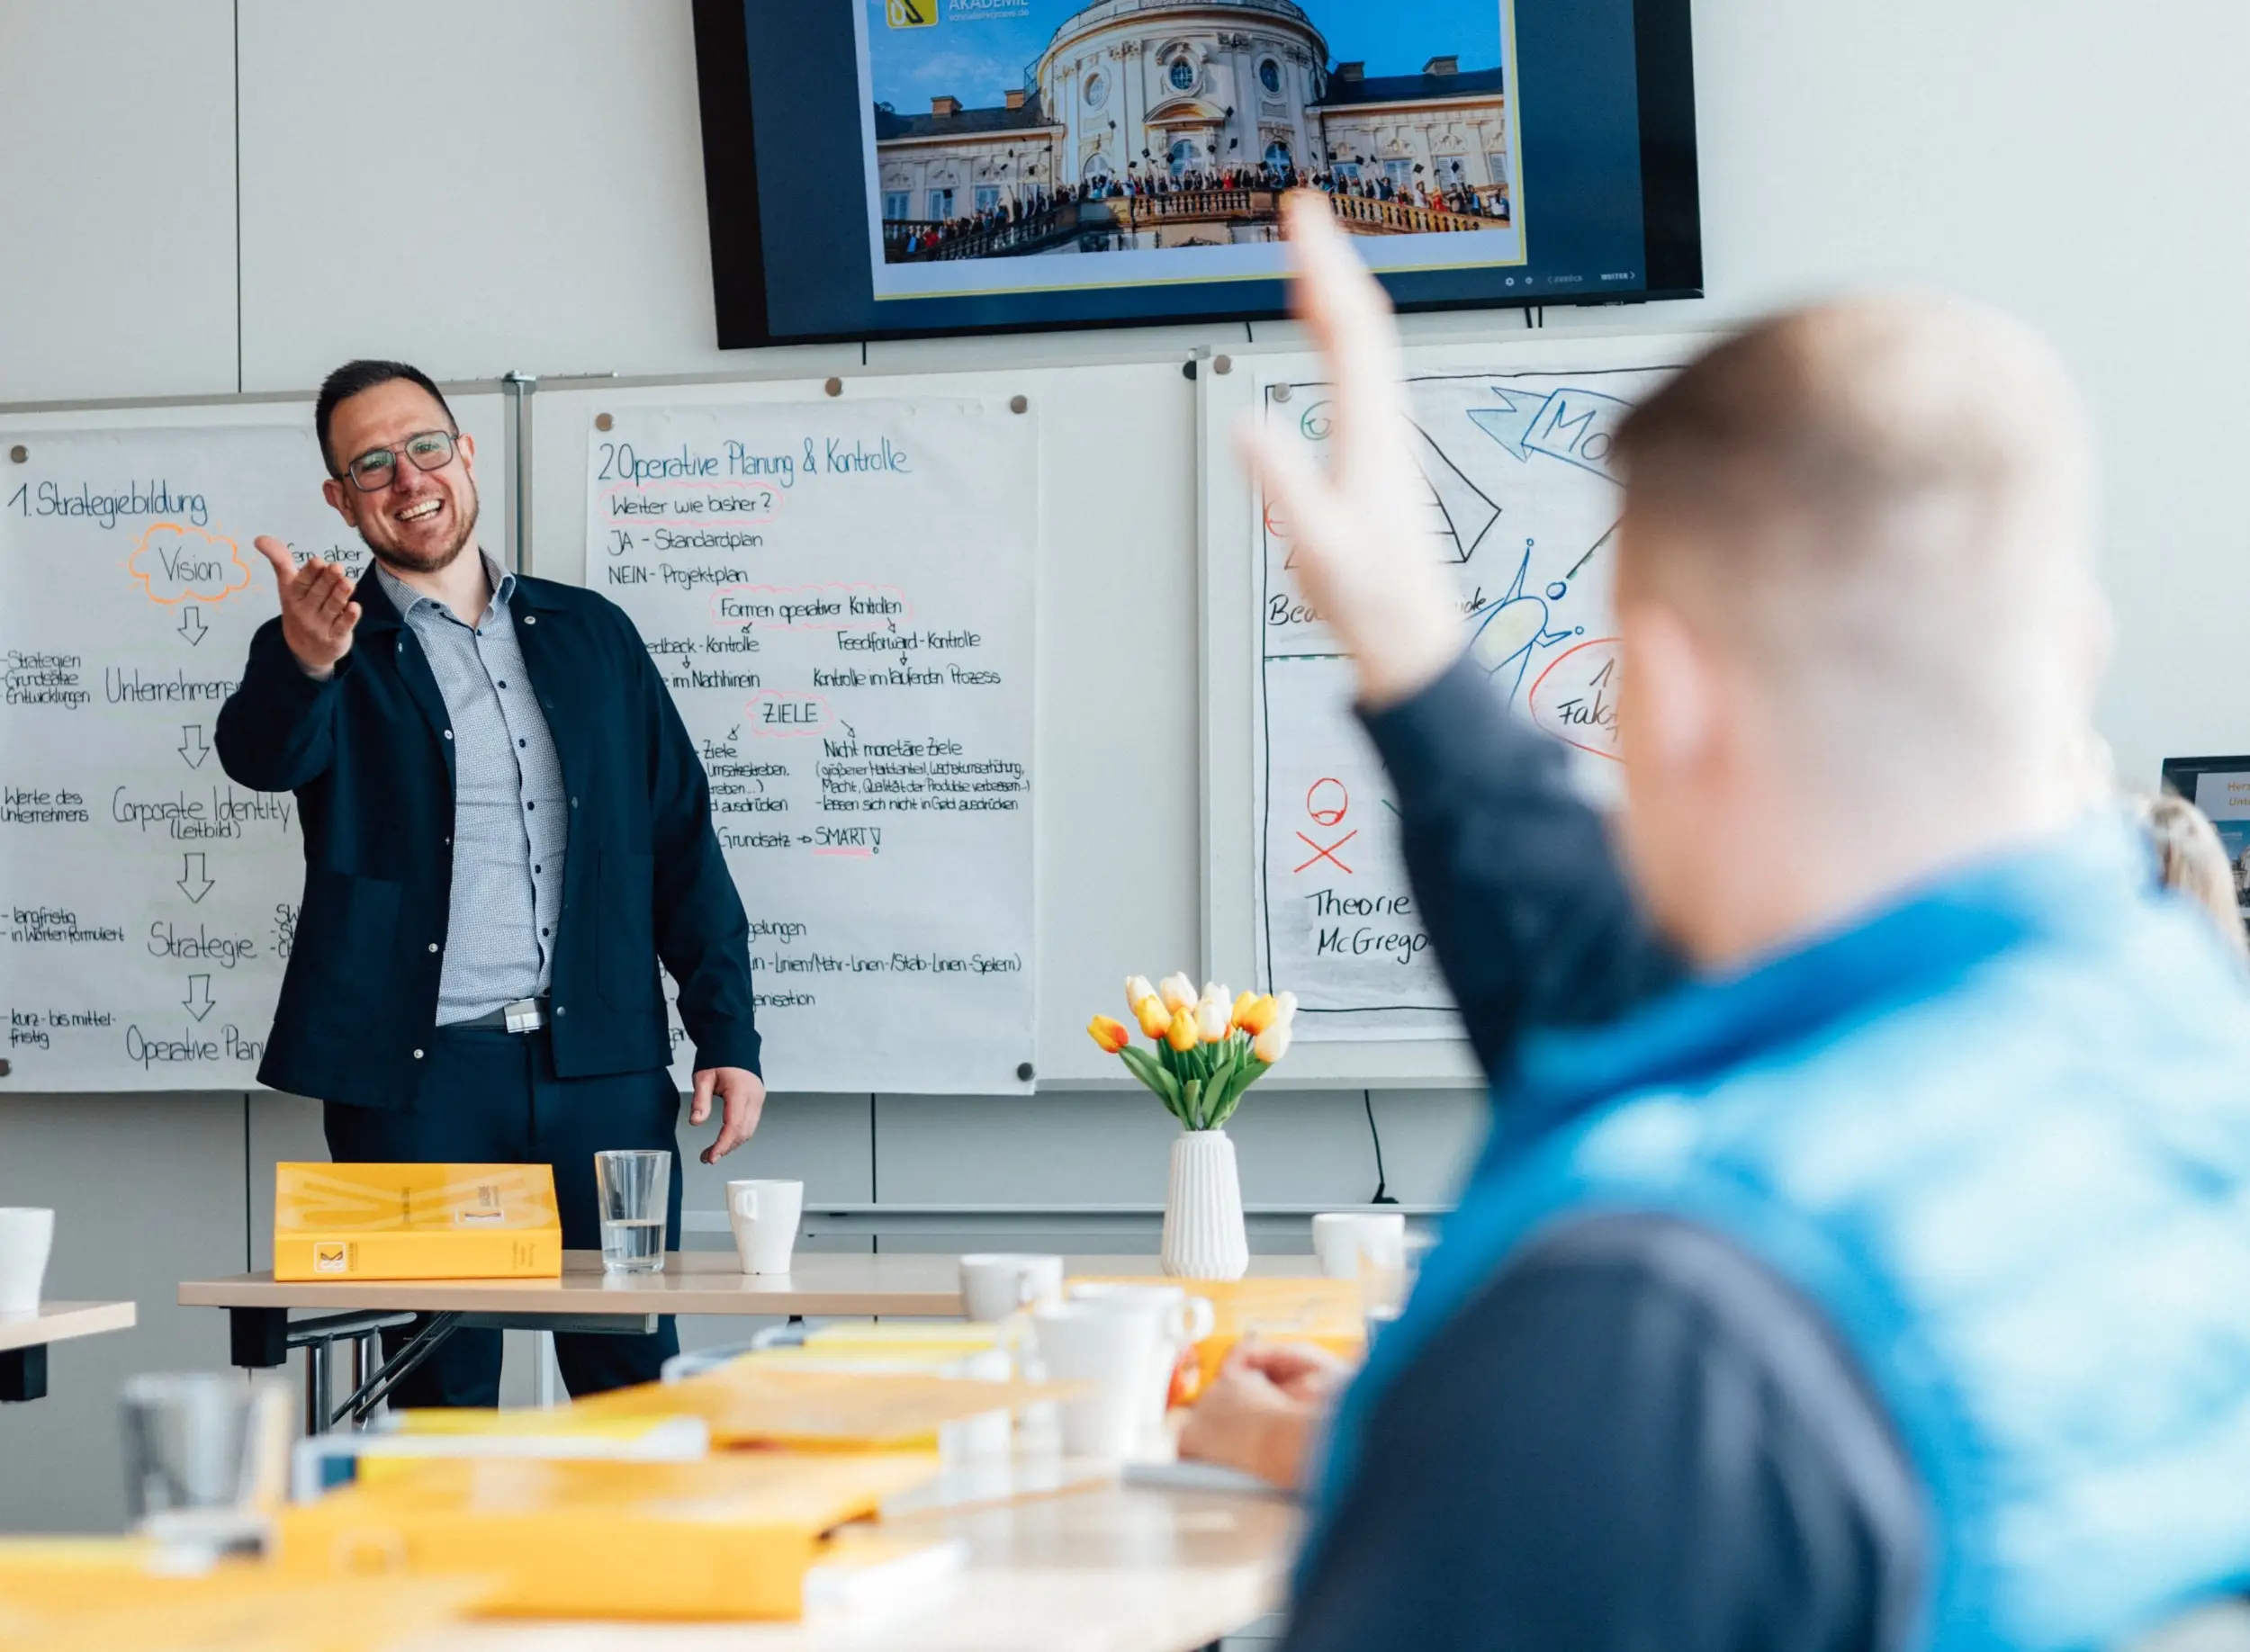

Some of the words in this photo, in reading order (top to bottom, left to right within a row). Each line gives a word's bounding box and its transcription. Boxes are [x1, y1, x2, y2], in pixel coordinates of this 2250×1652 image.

[723, 439, 794, 488] Planung
[803, 437, 818, 475] &
[826, 437, 913, 474] Kontrolle
[612, 493, 669, 516] Weiter
[674, 495, 703, 514] wie
[707, 491, 758, 513] bisher
[323, 543, 364, 562] aber
[608, 529, 634, 556] JA
[654, 528, 764, 550] Standardplan
[158, 546, 222, 581] Vision
[660, 562, 749, 590] Projektplan
[721, 598, 774, 618] Formen
[779, 597, 842, 624] operativer
[849, 595, 903, 616] Kontrollen
[105, 667, 241, 704] Unternehmens
[672, 672, 689, 688] im
[692, 669, 760, 688] Nachhinein
[814, 667, 866, 688] Kontrolle
[868, 669, 887, 687] im
[888, 666, 943, 687] laufenden
[946, 662, 1002, 685] Prozess
[762, 703, 818, 723] ZIELE
[703, 739, 738, 759] Ziele
[823, 738, 859, 759] Nicht
[863, 740, 923, 758] monetäre
[927, 737, 963, 757] Ziele
[4, 786, 50, 806] Werte
[55, 788, 83, 806] des
[906, 779, 925, 793] der
[112, 786, 208, 832] Corporate
[213, 785, 291, 833] Identity
[862, 796, 886, 811] sich
[889, 796, 918, 811] nicht
[921, 797, 932, 810] in
[932, 795, 956, 811] Geld
[170, 819, 241, 839] (Leitbild)
[717, 826, 791, 849] Grundsatz
[1305, 888, 1411, 917] Theorie
[14, 906, 76, 933] langfristig
[148, 921, 257, 969] Strategie
[748, 921, 806, 944] gelungen
[1317, 926, 1431, 965] McGrego
[9, 1028, 50, 1050] fristig
[126, 1024, 219, 1071] Operative
